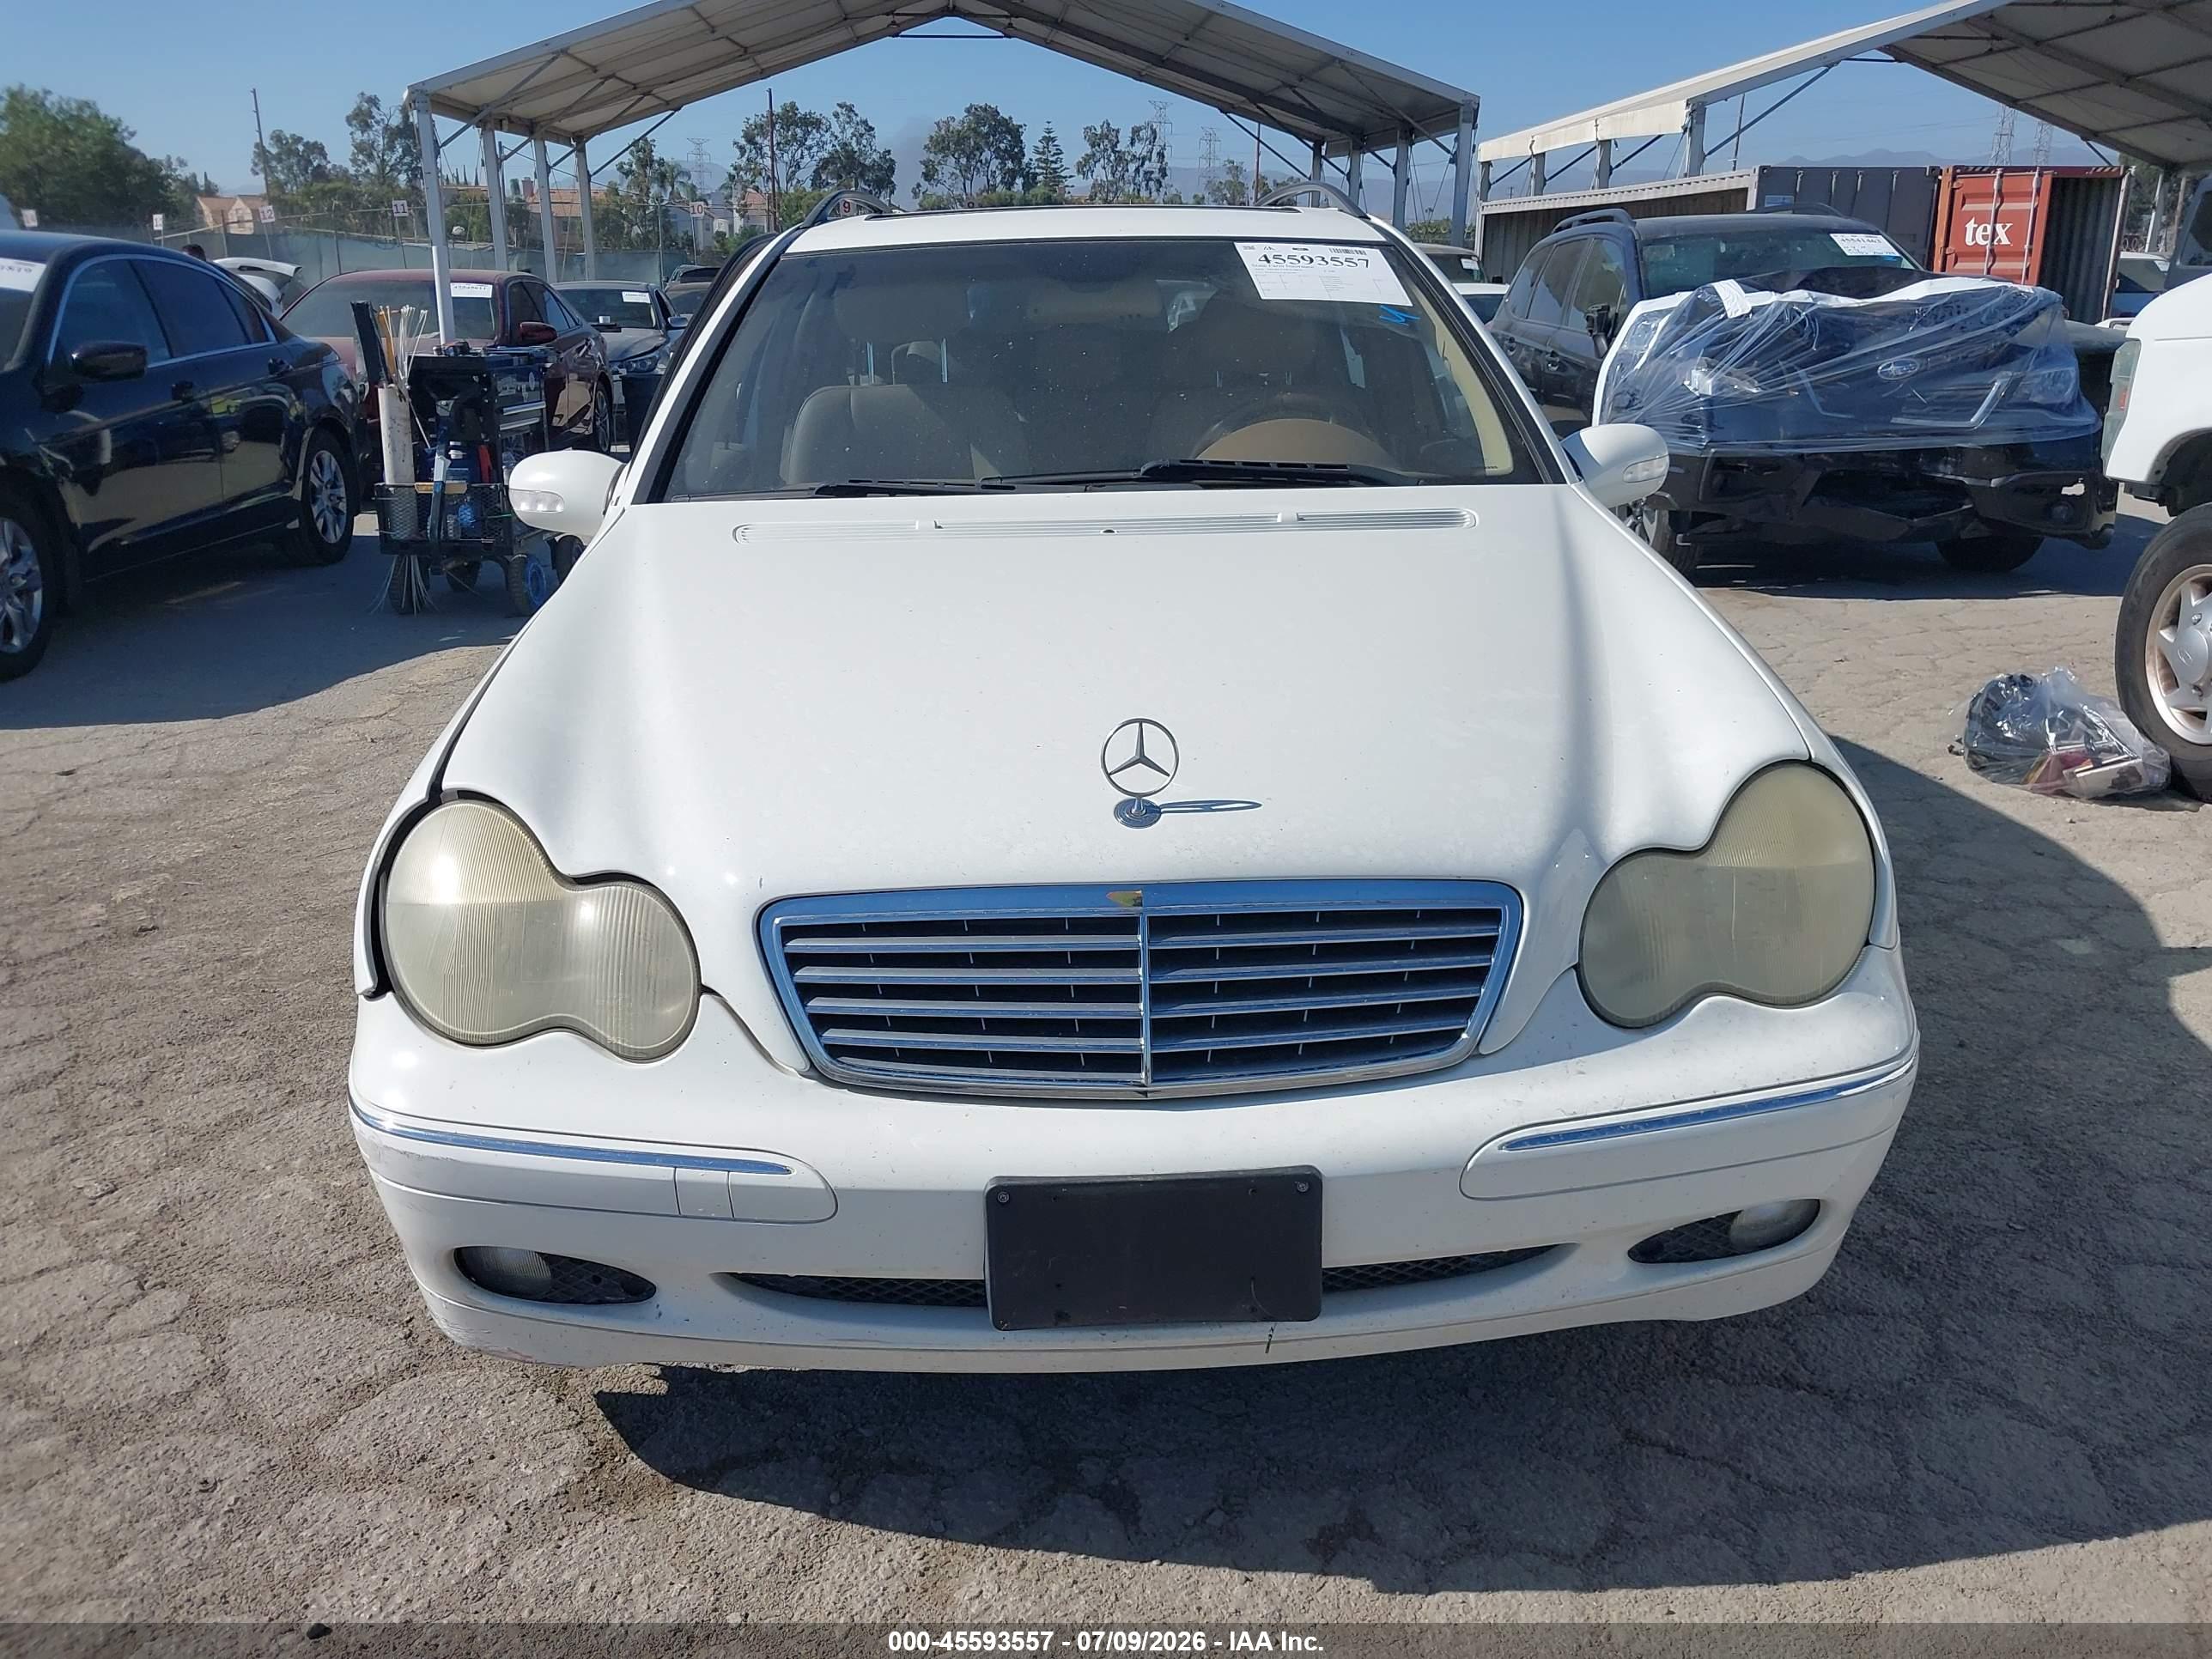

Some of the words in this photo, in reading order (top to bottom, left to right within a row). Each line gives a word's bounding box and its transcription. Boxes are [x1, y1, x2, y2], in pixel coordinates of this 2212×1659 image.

[393, 204, 408, 214] 11
[690, 204, 703, 215] 10
[842, 200, 851, 214] 9
[260, 209, 274, 221] 12
[1965, 216, 2014, 246] tex
[1258, 253, 1370, 269] 45593557
